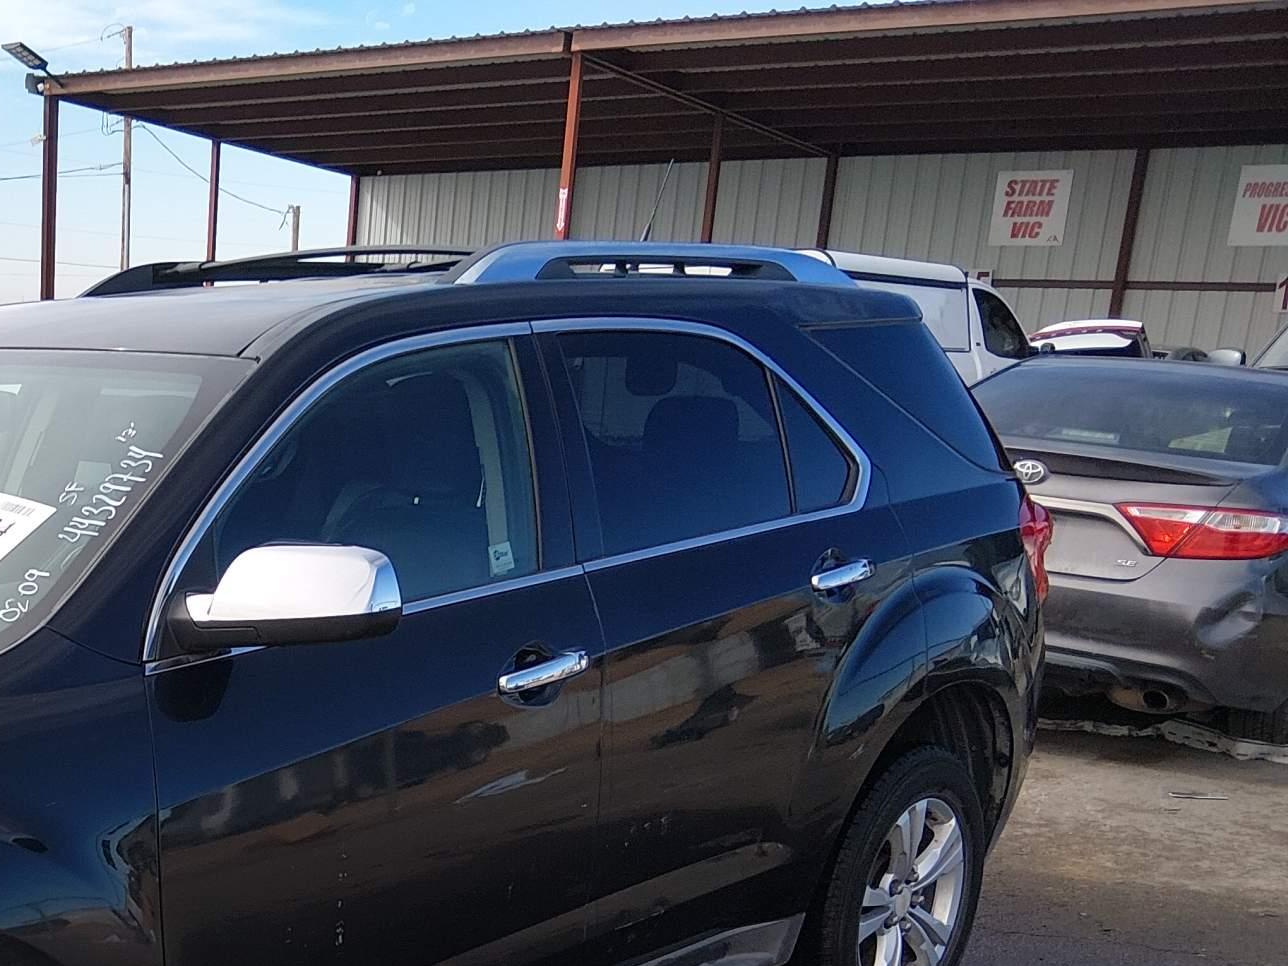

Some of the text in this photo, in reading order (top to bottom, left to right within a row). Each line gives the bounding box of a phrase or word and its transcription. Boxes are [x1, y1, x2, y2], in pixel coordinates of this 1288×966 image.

[1004, 179, 1060, 197] STATE
[1002, 200, 1055, 218] FARM
[1010, 221, 1043, 239] VIC
[58, 445, 164, 543] 44329734
